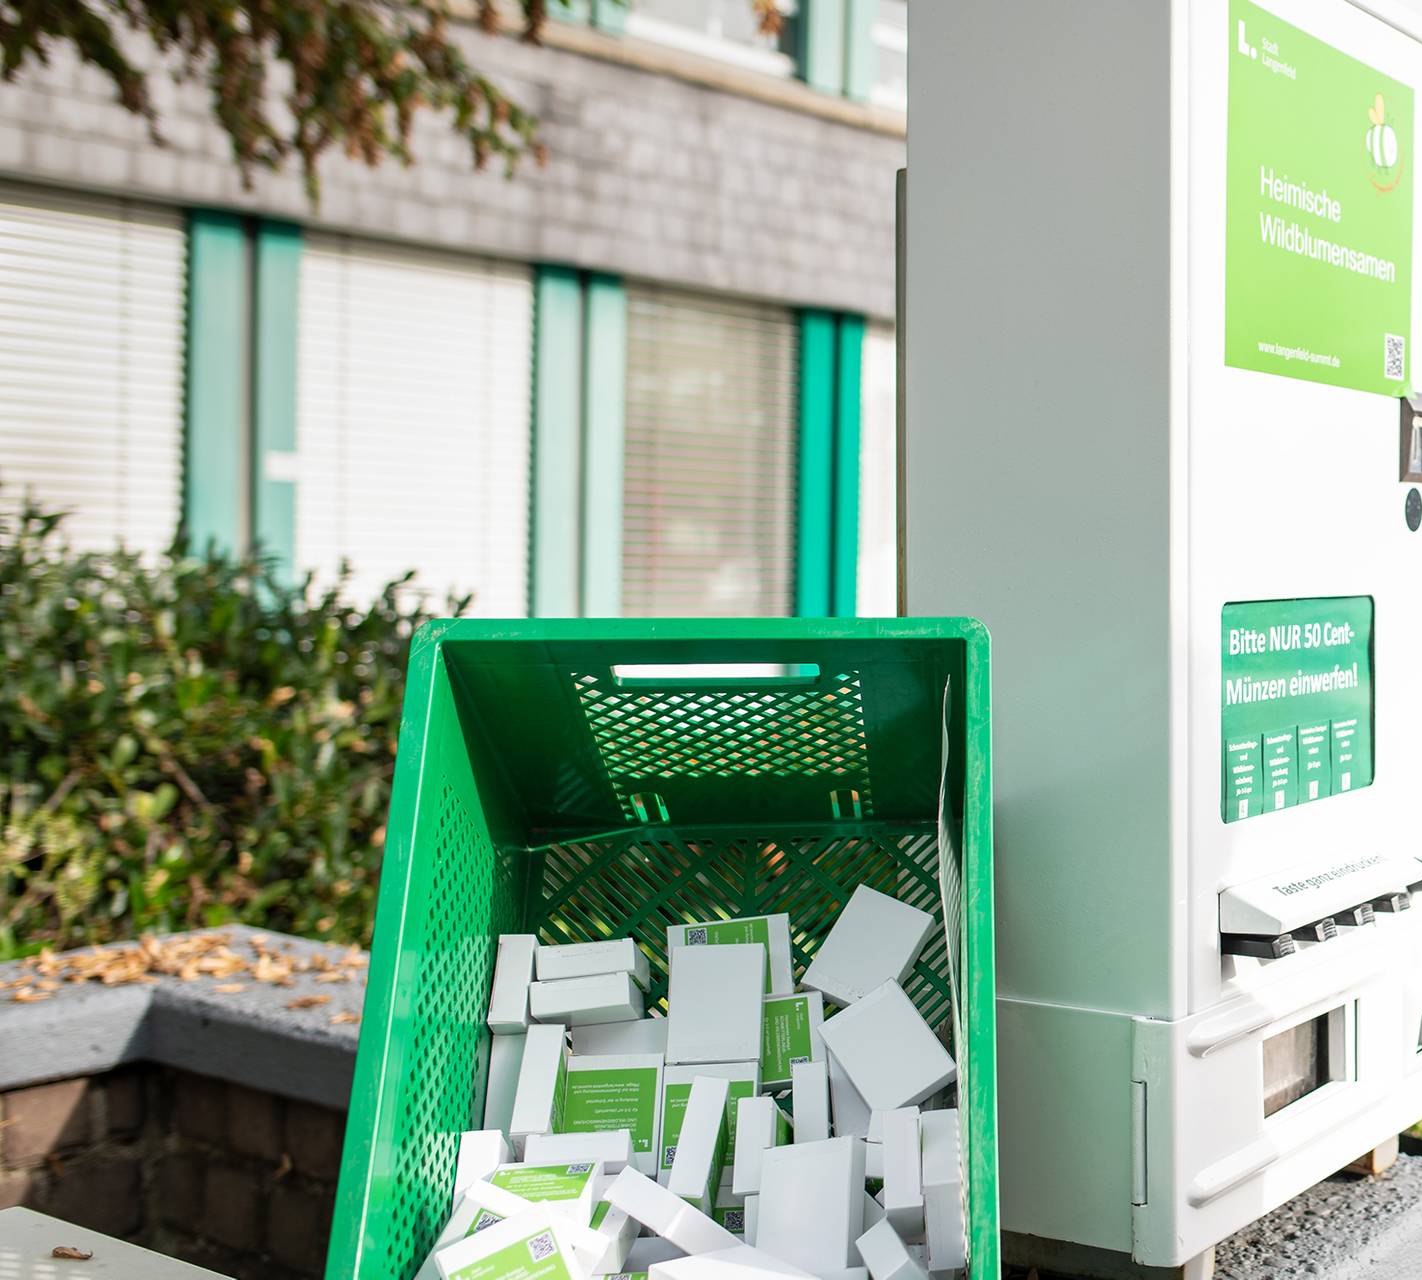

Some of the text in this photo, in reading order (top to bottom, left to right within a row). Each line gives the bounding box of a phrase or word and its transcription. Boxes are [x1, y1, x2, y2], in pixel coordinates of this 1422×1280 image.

[1262, 52, 1297, 80] Langenfeld
[1260, 165, 1341, 223] Heimische
[1260, 212, 1396, 283] Wildblumensamen
[1229, 621, 1355, 655] Bitte NUR 50 Cent-
[1226, 661, 1358, 705] Münzen einwerfen!
[1272, 880, 1309, 896] Taste
[1305, 872, 1334, 889] ganz
